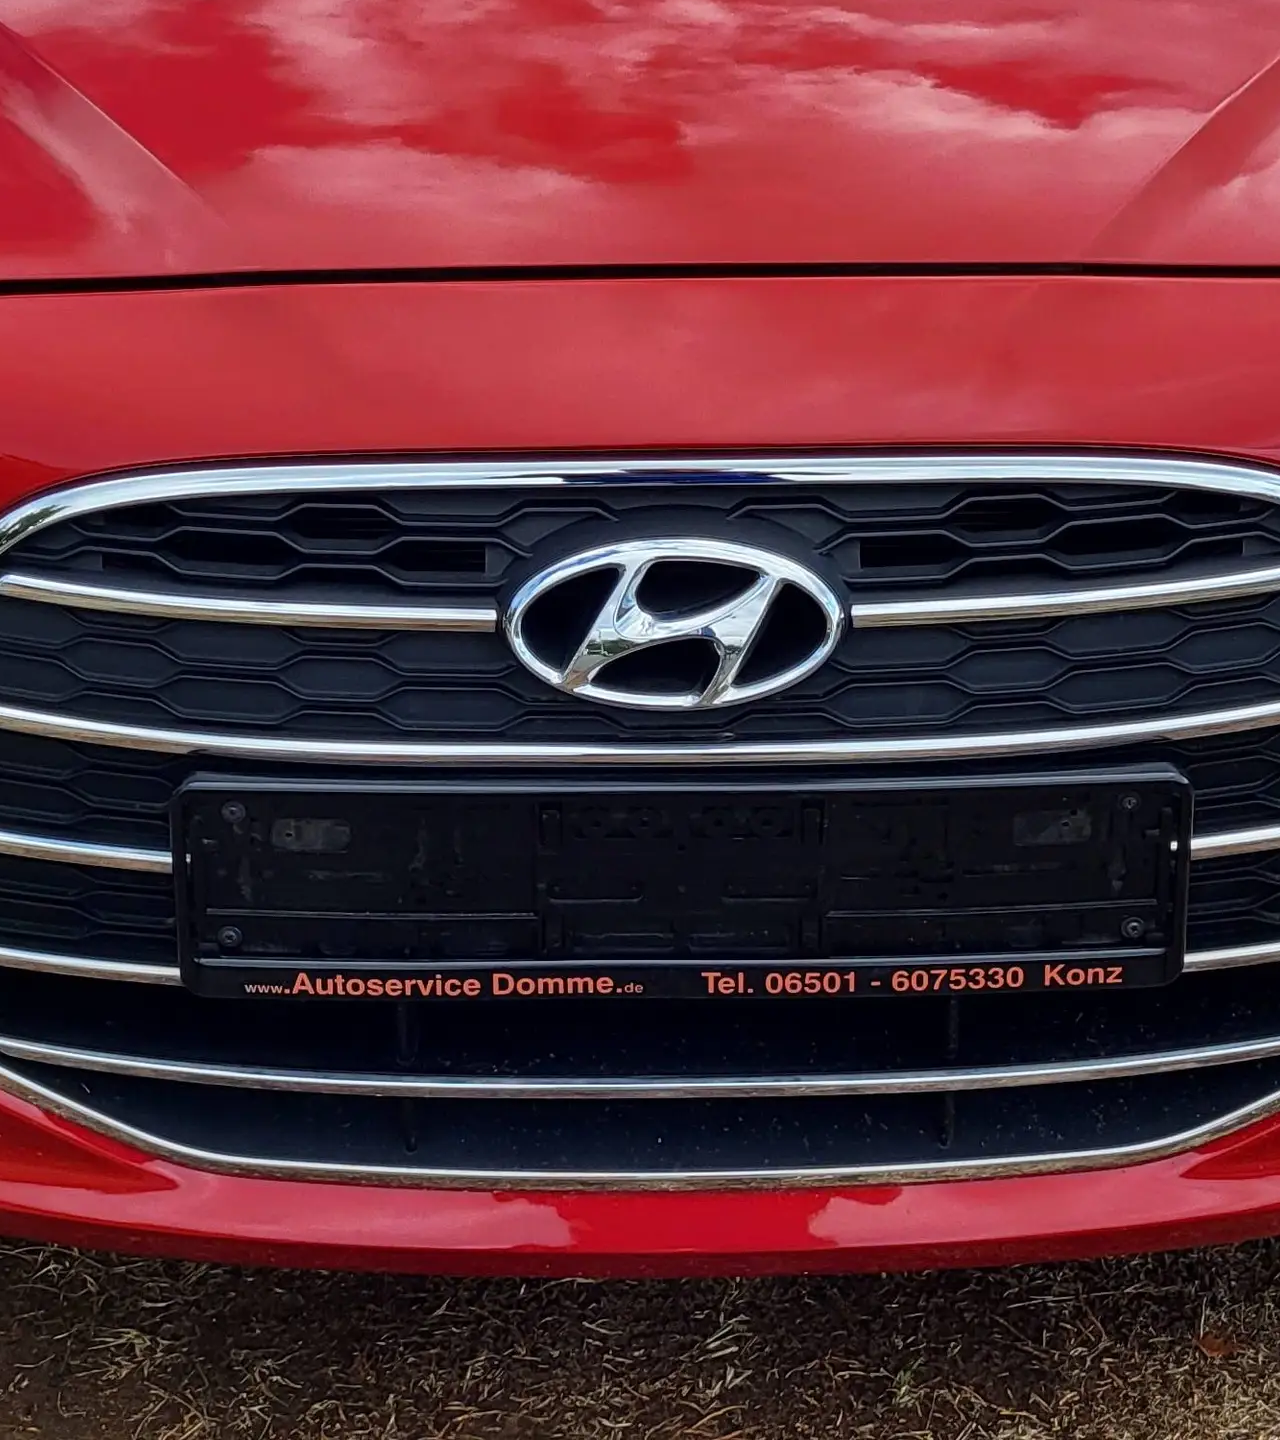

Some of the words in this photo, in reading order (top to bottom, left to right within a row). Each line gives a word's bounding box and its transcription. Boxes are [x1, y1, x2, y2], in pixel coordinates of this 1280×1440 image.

[244, 972, 481, 996] www.Autoservice
[492, 973, 644, 996] Domme.de
[701, 971, 754, 994] Tel.
[765, 971, 856, 994] 06501
[891, 966, 1025, 992] 6075330
[1044, 964, 1123, 987] Konz
